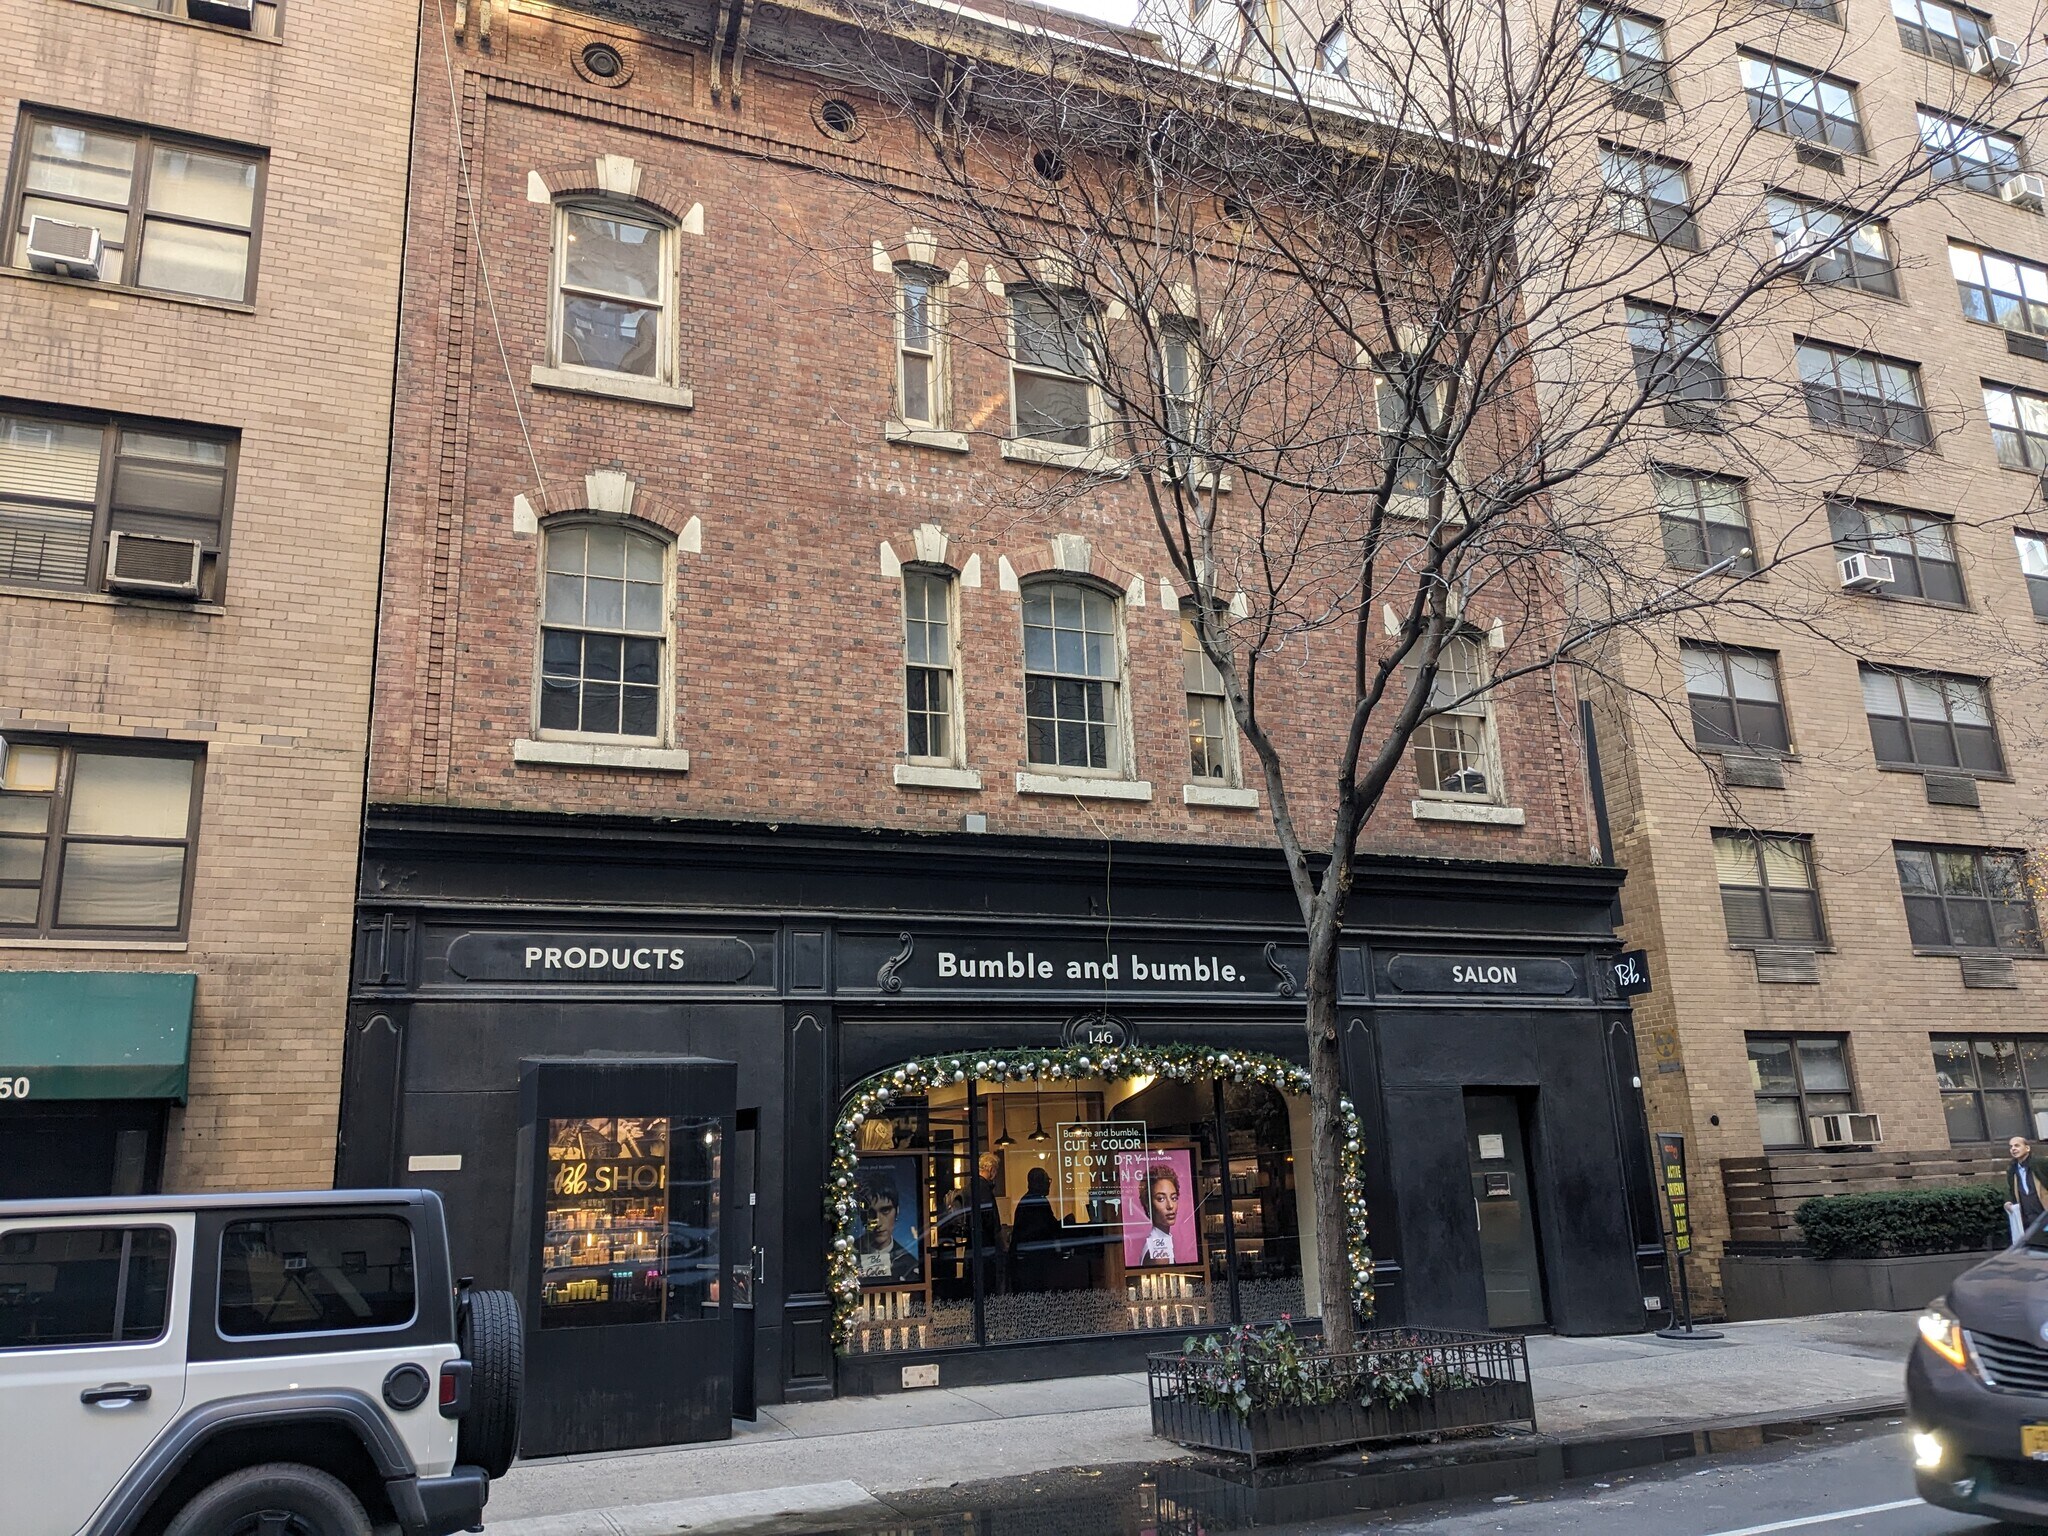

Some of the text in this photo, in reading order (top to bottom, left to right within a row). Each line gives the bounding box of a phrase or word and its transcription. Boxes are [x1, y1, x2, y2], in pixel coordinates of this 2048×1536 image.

[525, 947, 685, 970] PRODUCTS
[937, 952, 1246, 982] Bumble and bumble.
[1452, 965, 1518, 984] SALON
[1088, 1030, 1113, 1045] 146
[1094, 1128, 1109, 1137] and
[1110, 1127, 1141, 1137] bumble.
[1063, 1140, 1087, 1151] CUT
[1101, 1139, 1141, 1150] COLOR
[1064, 1154, 1142, 1167] BLOW DRY
[1065, 1169, 1144, 1184] STYLING
[1152, 1250, 1170, 1259] Color
[866, 1266, 887, 1277] Color
